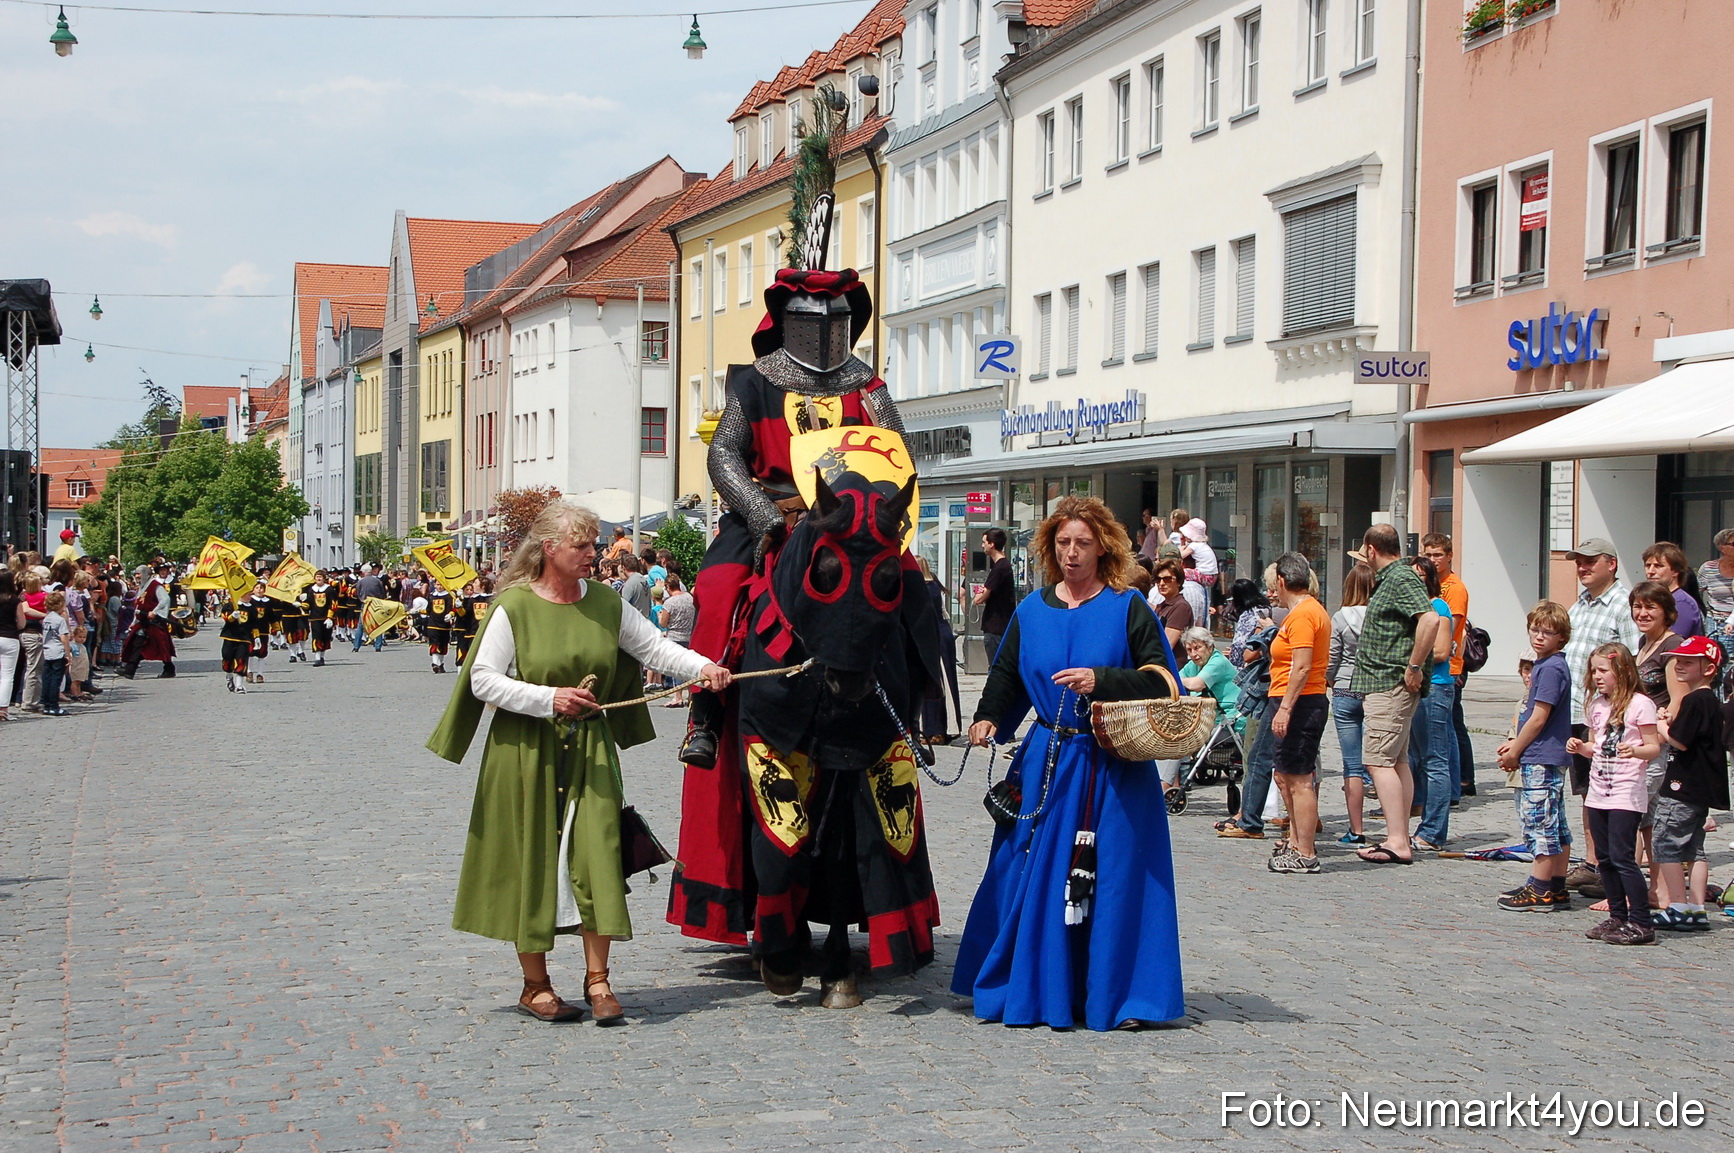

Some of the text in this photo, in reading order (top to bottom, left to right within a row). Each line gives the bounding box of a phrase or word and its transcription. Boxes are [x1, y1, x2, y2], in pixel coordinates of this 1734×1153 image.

[1000, 388, 1140, 437] Buchhandlung Rupprecht
[1214, 480, 1237, 497] Rupprecht
[1301, 475, 1328, 493] Rupprecht
[1705, 643, 1717, 659] 31
